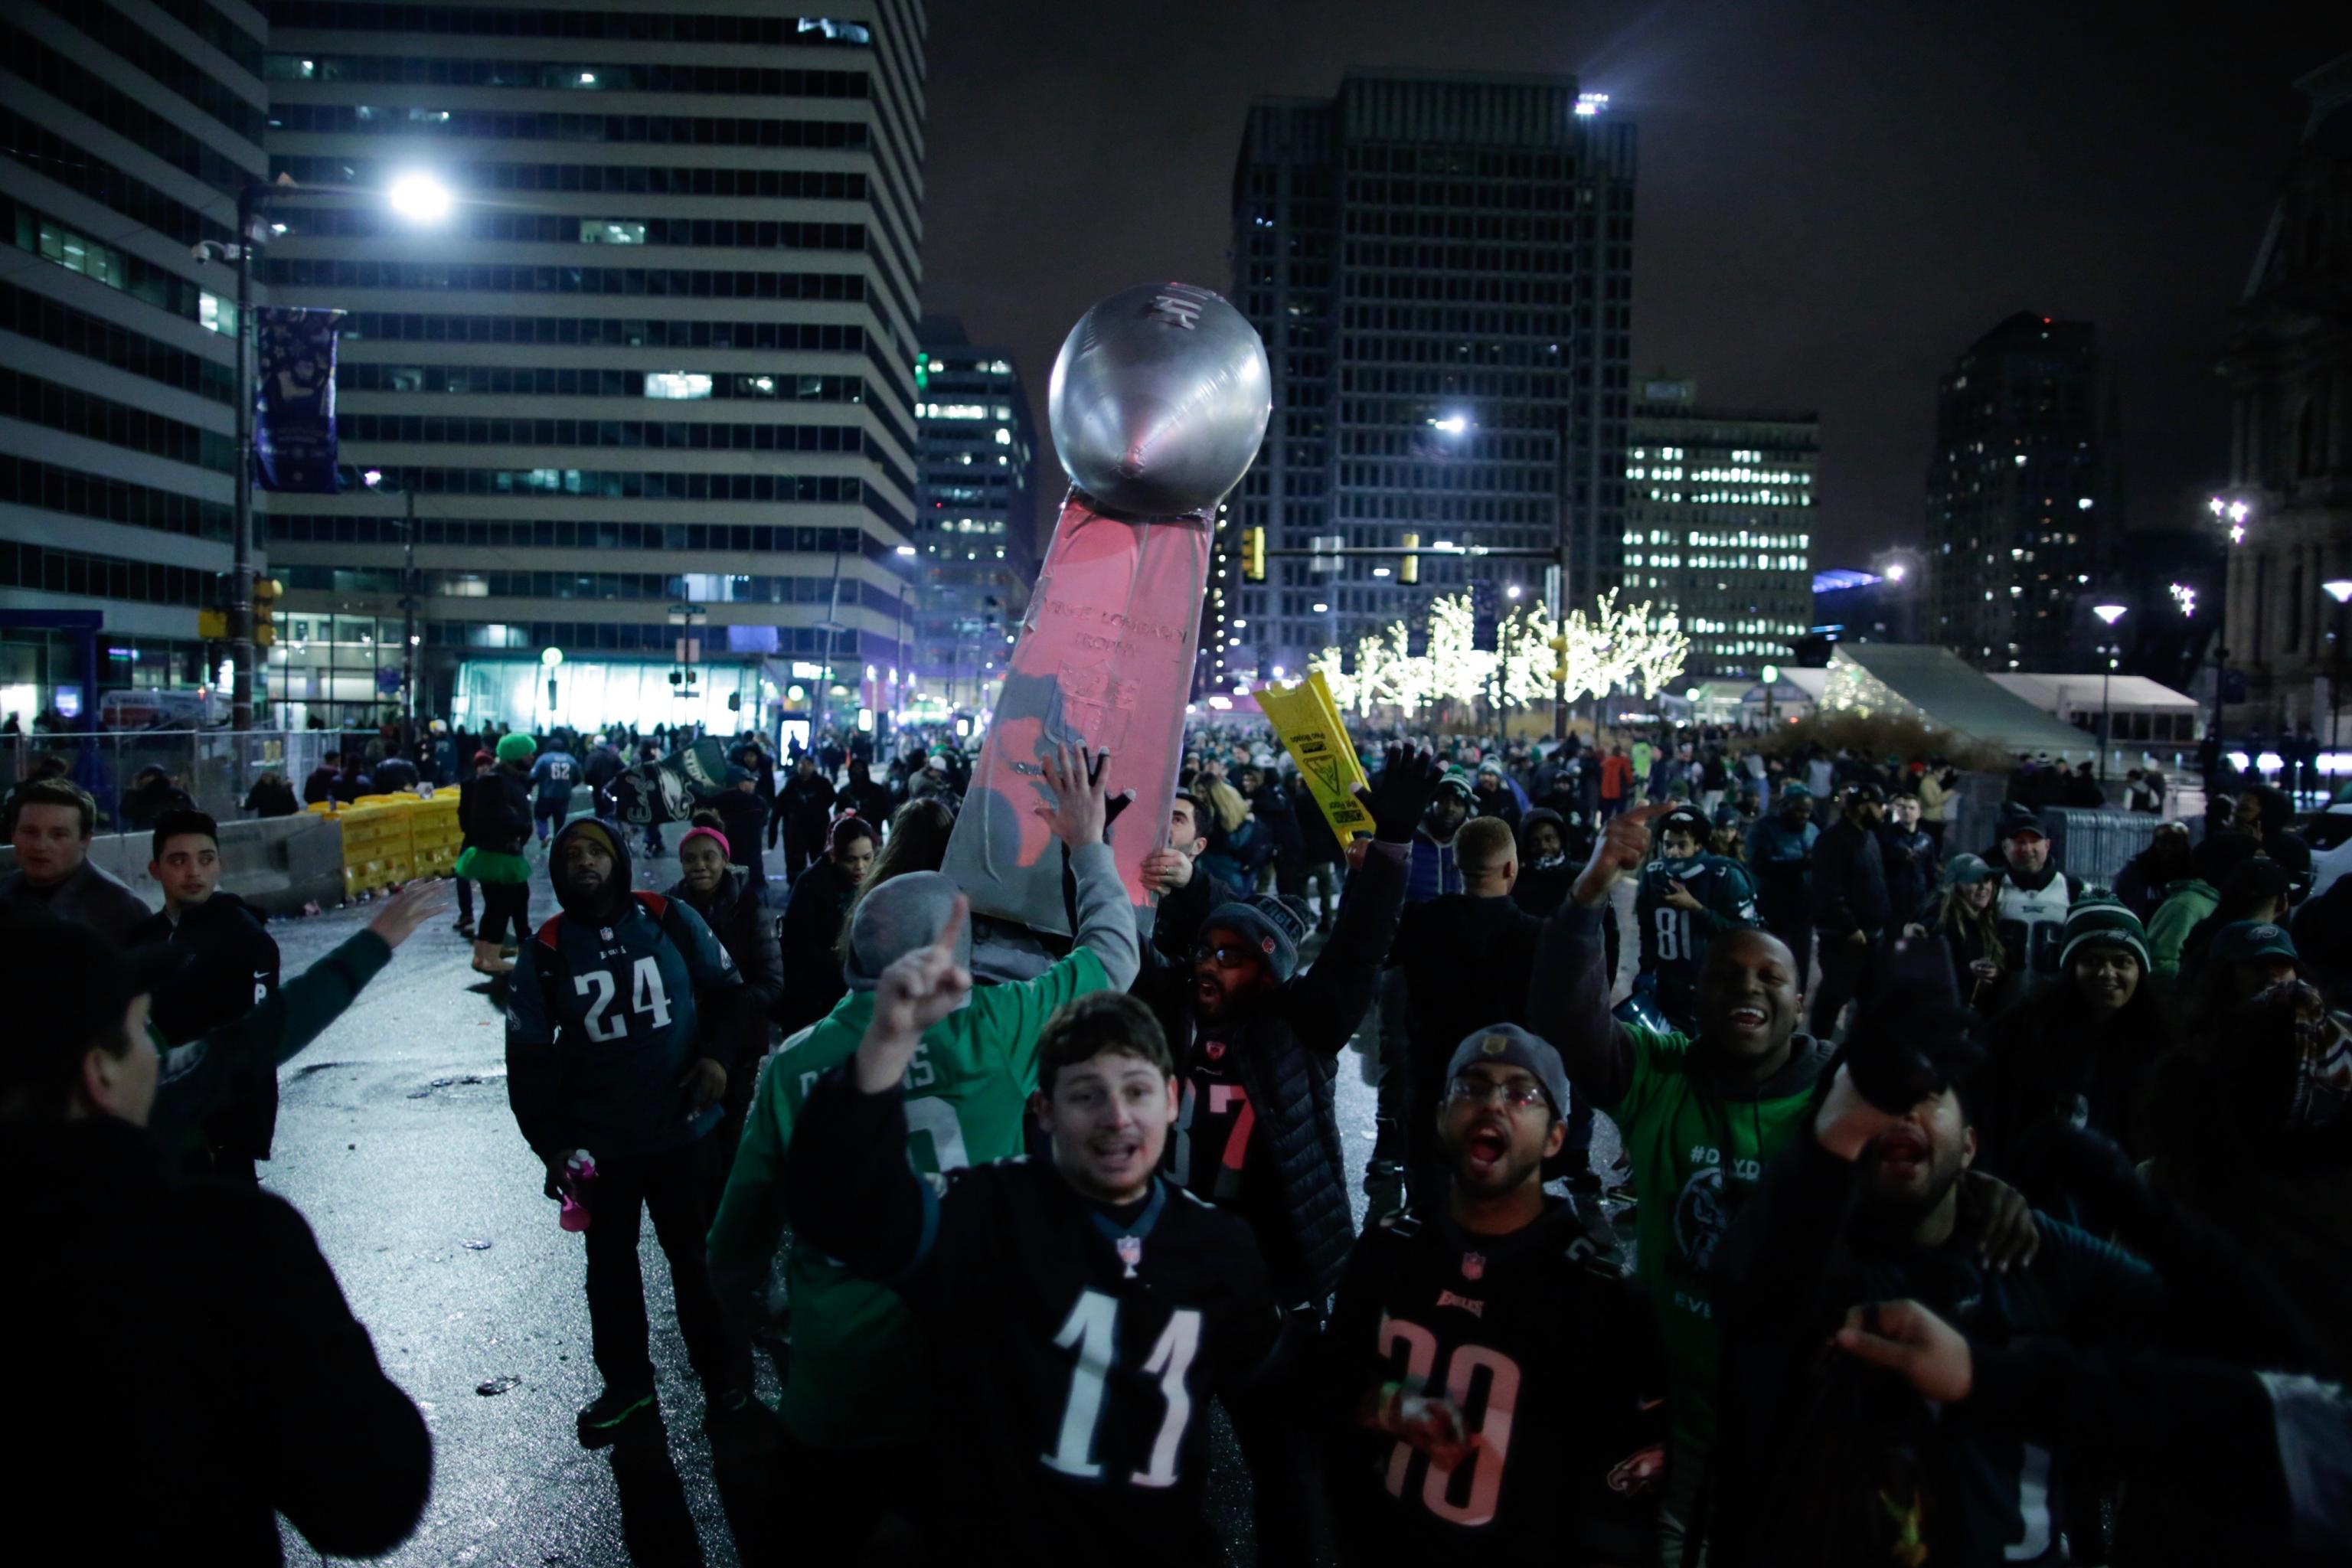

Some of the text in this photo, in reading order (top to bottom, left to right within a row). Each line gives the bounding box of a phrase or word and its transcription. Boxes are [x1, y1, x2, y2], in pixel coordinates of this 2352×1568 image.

[550, 762, 571, 780] 62
[1655, 906, 1691, 962] 81
[573, 956, 672, 1043] 24
[1040, 1288, 1203, 1488] 11
